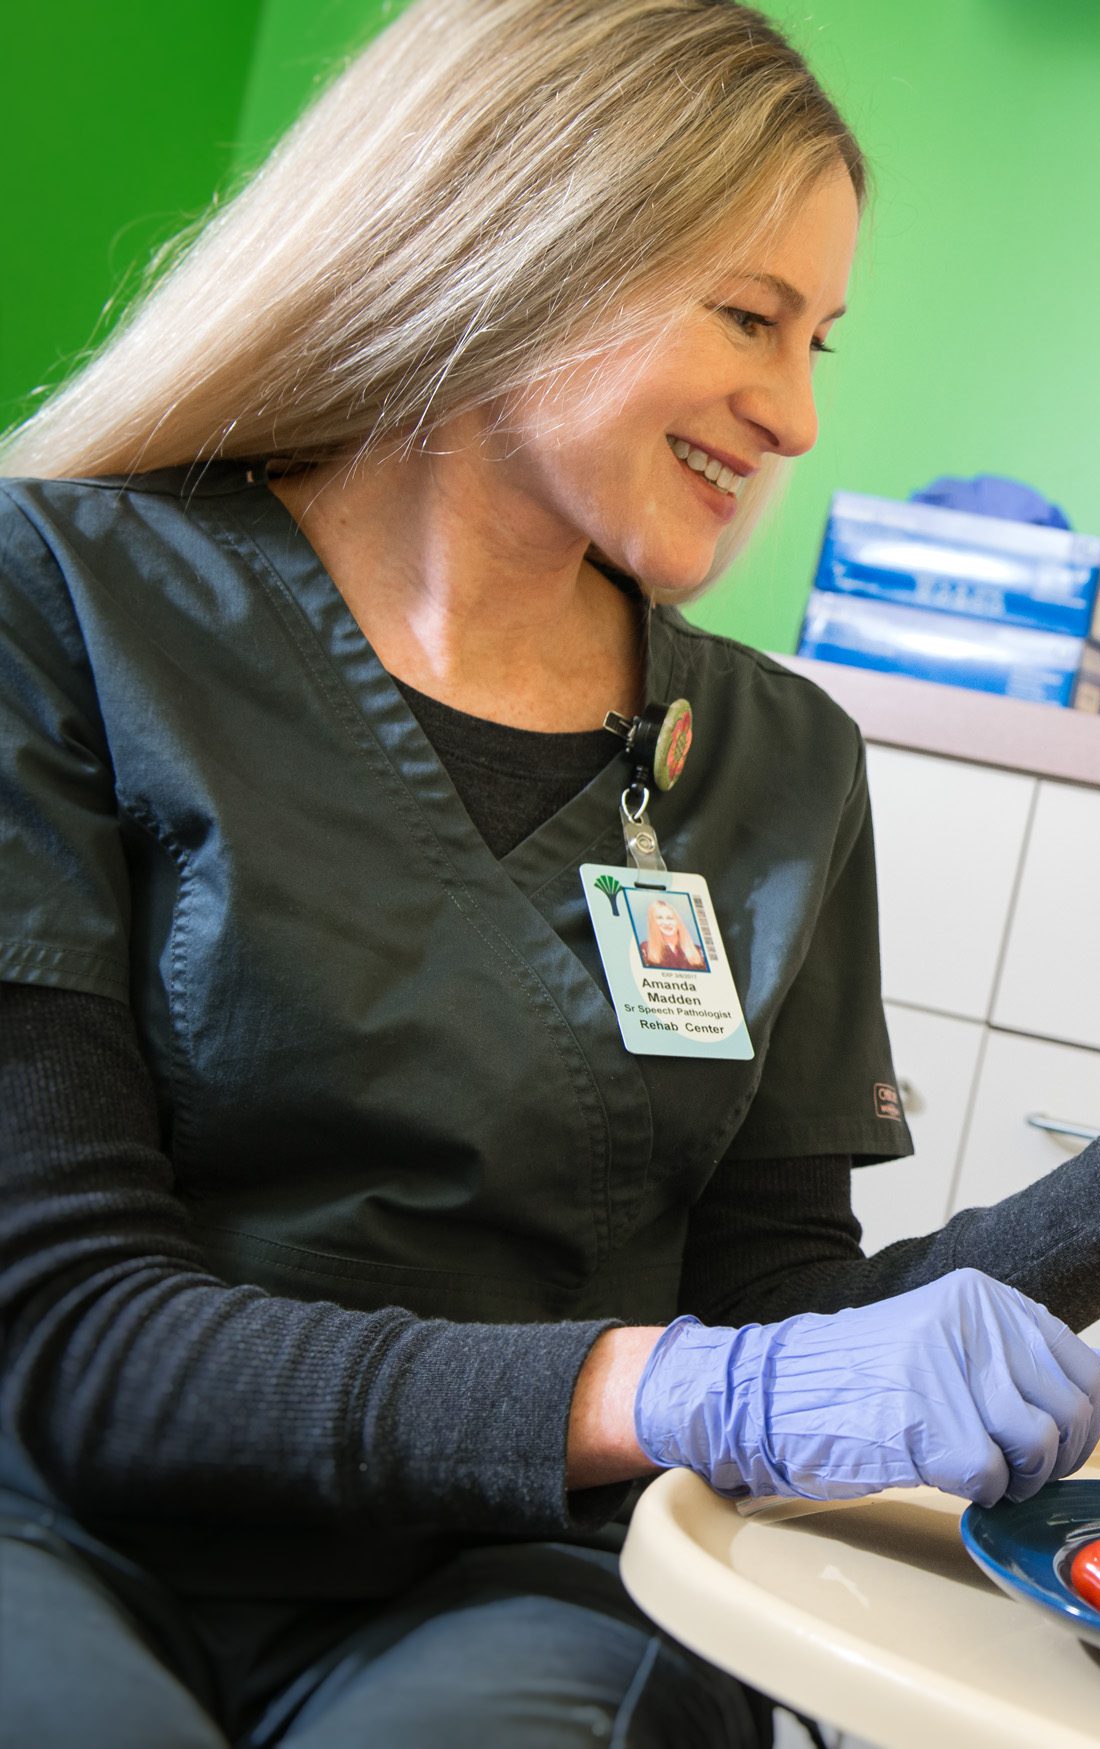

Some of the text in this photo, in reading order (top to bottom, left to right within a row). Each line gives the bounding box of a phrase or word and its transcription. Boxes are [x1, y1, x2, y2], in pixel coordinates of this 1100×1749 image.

[642, 978, 697, 992] Amanda
[647, 992, 701, 1006] Madden
[624, 1004, 732, 1020] Sr Speech Pathologist
[640, 1020, 725, 1034] Rehab Center
